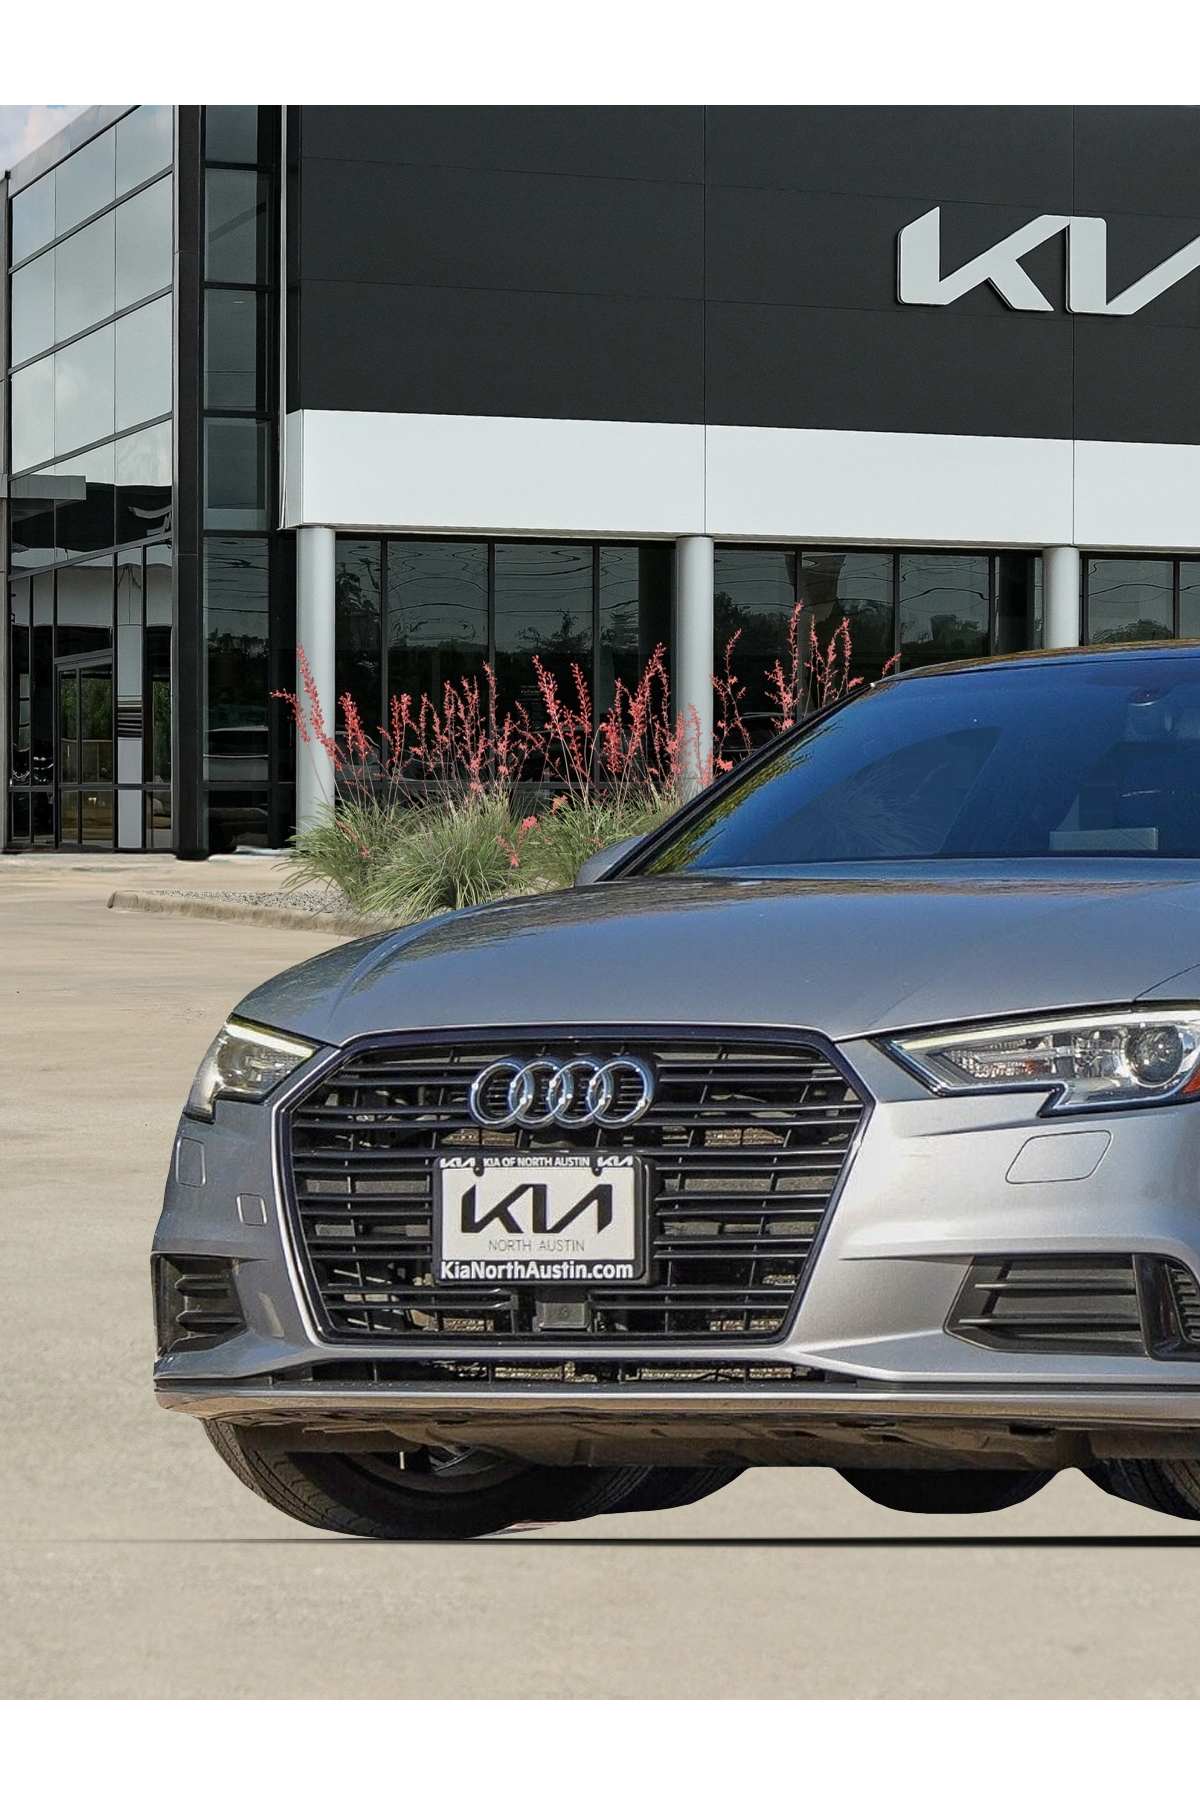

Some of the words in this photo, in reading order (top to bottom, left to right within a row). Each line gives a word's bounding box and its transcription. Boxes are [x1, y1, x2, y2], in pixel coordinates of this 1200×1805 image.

[483, 1157, 500, 1167] KIA
[502, 1157, 516, 1167] OF
[517, 1157, 552, 1167] NORTH
[554, 1157, 590, 1167] AUSTIN
[461, 1183, 613, 1234] KIA
[488, 1240, 531, 1251] NORTH
[539, 1239, 585, 1251] AUSTIN
[441, 1261, 634, 1279] KiaNorthAustin.com
